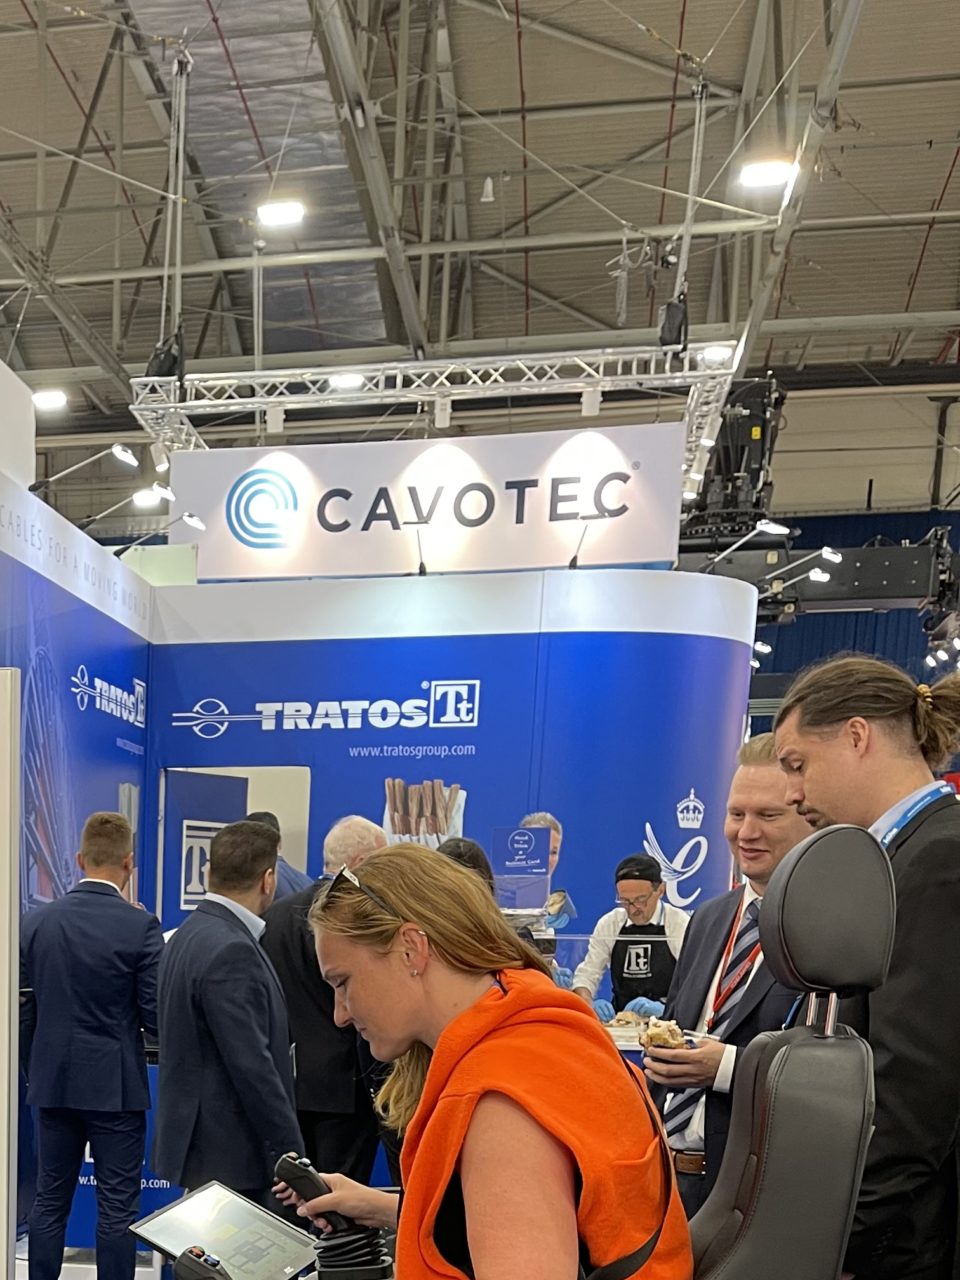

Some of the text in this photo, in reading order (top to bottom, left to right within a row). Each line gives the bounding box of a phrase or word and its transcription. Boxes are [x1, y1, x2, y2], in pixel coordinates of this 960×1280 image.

[316, 471, 632, 533] CAVOTEC
[0, 504, 42, 551] CABLES
[48, 537, 68, 569] FOR
[83, 561, 118, 601] MOVING
[94, 677, 136, 723] TRATOS
[255, 699, 429, 730] TRATOS
[349, 744, 476, 759] www.tratosgroup.com
